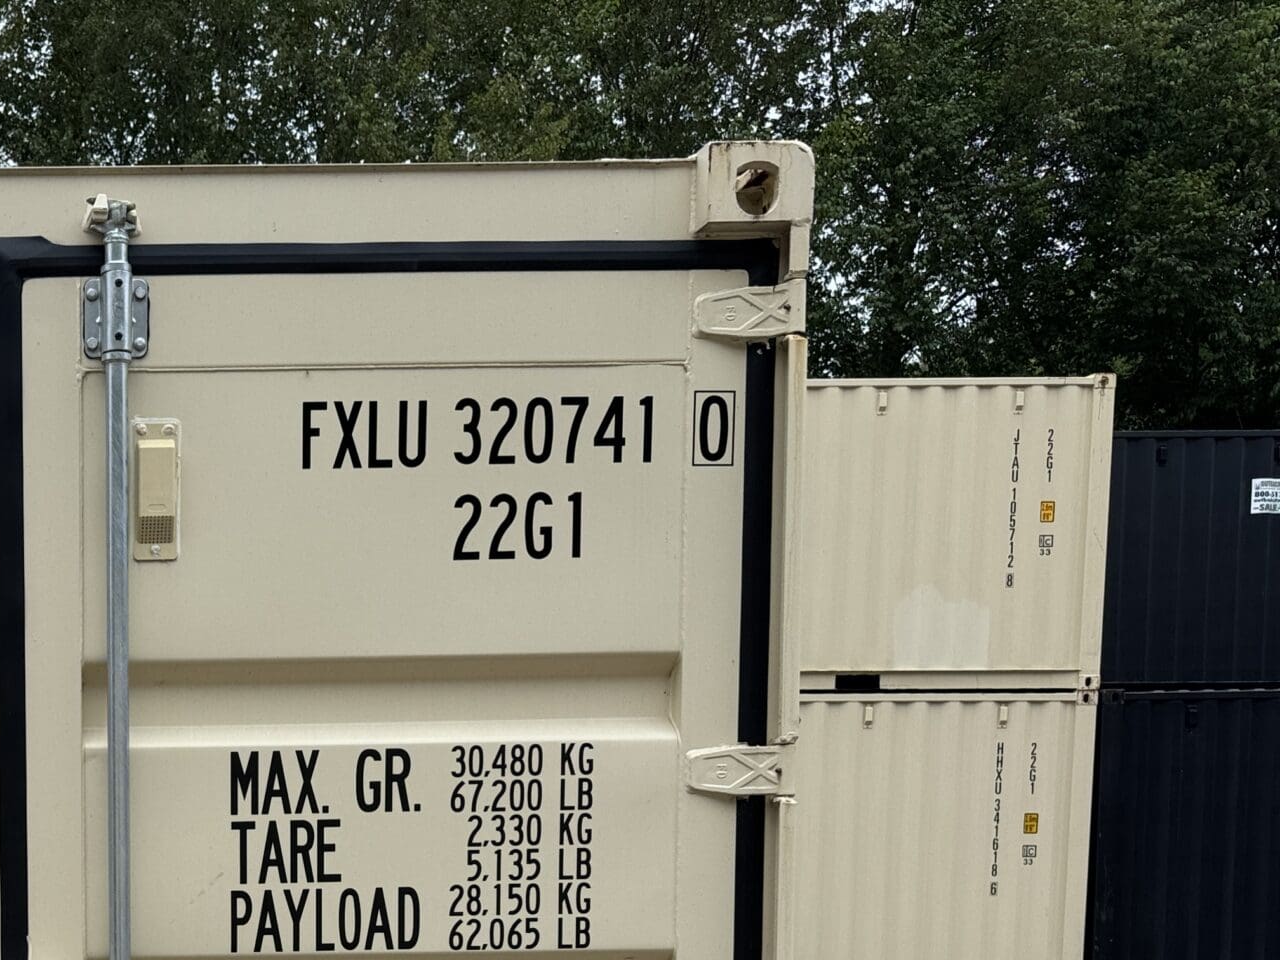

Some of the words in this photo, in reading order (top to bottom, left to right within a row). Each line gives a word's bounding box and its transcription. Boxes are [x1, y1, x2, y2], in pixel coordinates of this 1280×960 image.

[302, 399, 428, 470] FXLU
[453, 395, 654, 465] 320741
[699, 395, 729, 462] 0
[1011, 428, 1021, 483] JTAU
[1046, 428, 1054, 483] 22G1
[452, 491, 582, 561] 22G1
[1007, 487, 1017, 568] 105712
[1006, 574, 1014, 587] 8
[230, 749, 330, 816] MAX.
[355, 748, 421, 813] GR.
[450, 743, 544, 778] 30,480
[560, 742, 594, 776] KG
[994, 742, 1005, 795] HHXU
[1029, 742, 1038, 795] 22G1
[450, 779, 543, 816] 67,200
[559, 777, 593, 811] LB
[230, 818, 342, 885] TARE
[467, 813, 542, 848] 2,330
[559, 812, 593, 846] KG
[467, 848, 541, 882] 5,135
[558, 847, 592, 881] LB
[991, 798, 1001, 877] 341618
[990, 882, 998, 896] 6
[230, 886, 421, 954] PAYLOAD
[448, 882, 541, 917] 28,150
[558, 882, 592, 915] KG
[448, 917, 540, 951] 62,065
[557, 916, 591, 950] LB
